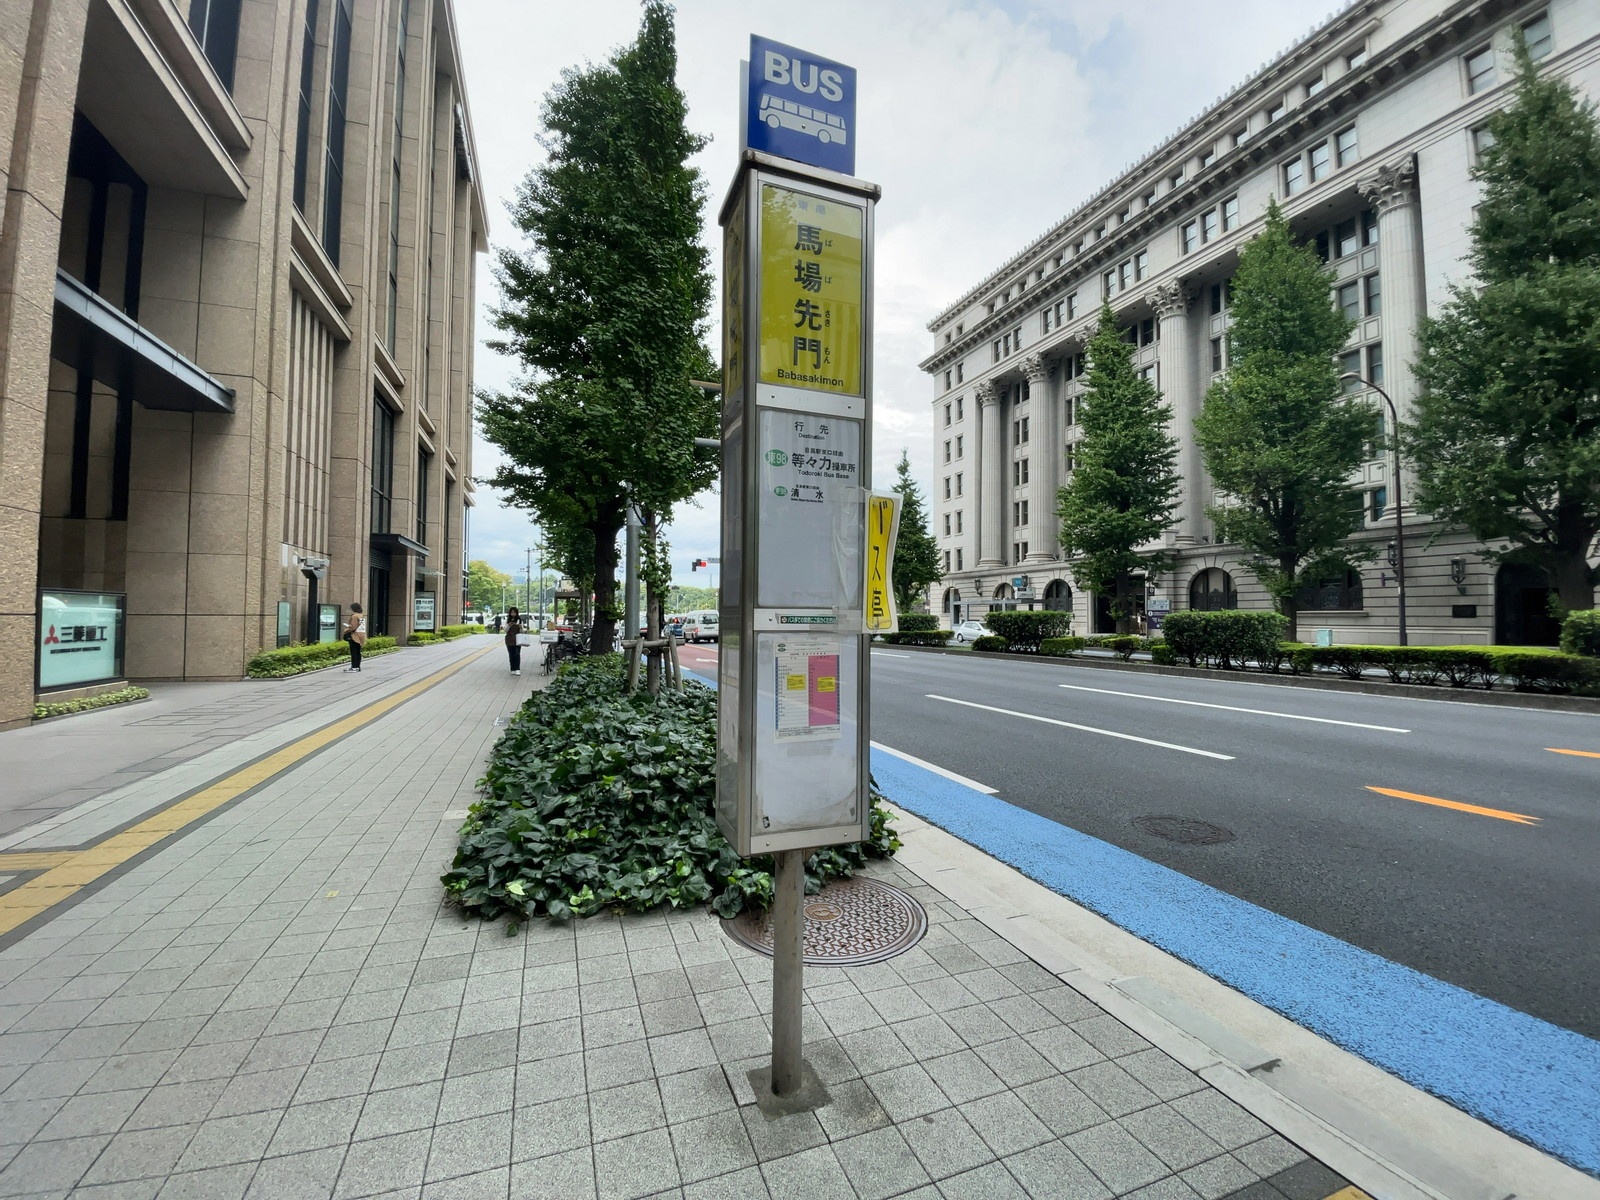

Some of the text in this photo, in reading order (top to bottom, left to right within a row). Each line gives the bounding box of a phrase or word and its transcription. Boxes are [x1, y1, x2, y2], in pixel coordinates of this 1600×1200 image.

[764, 50, 844, 102] BUS
[793, 222, 824, 370] 馬場先門
[777, 369, 844, 387] Babasakimon
[798, 469, 823, 477] Todoroki
[836, 472, 850, 480] Base
